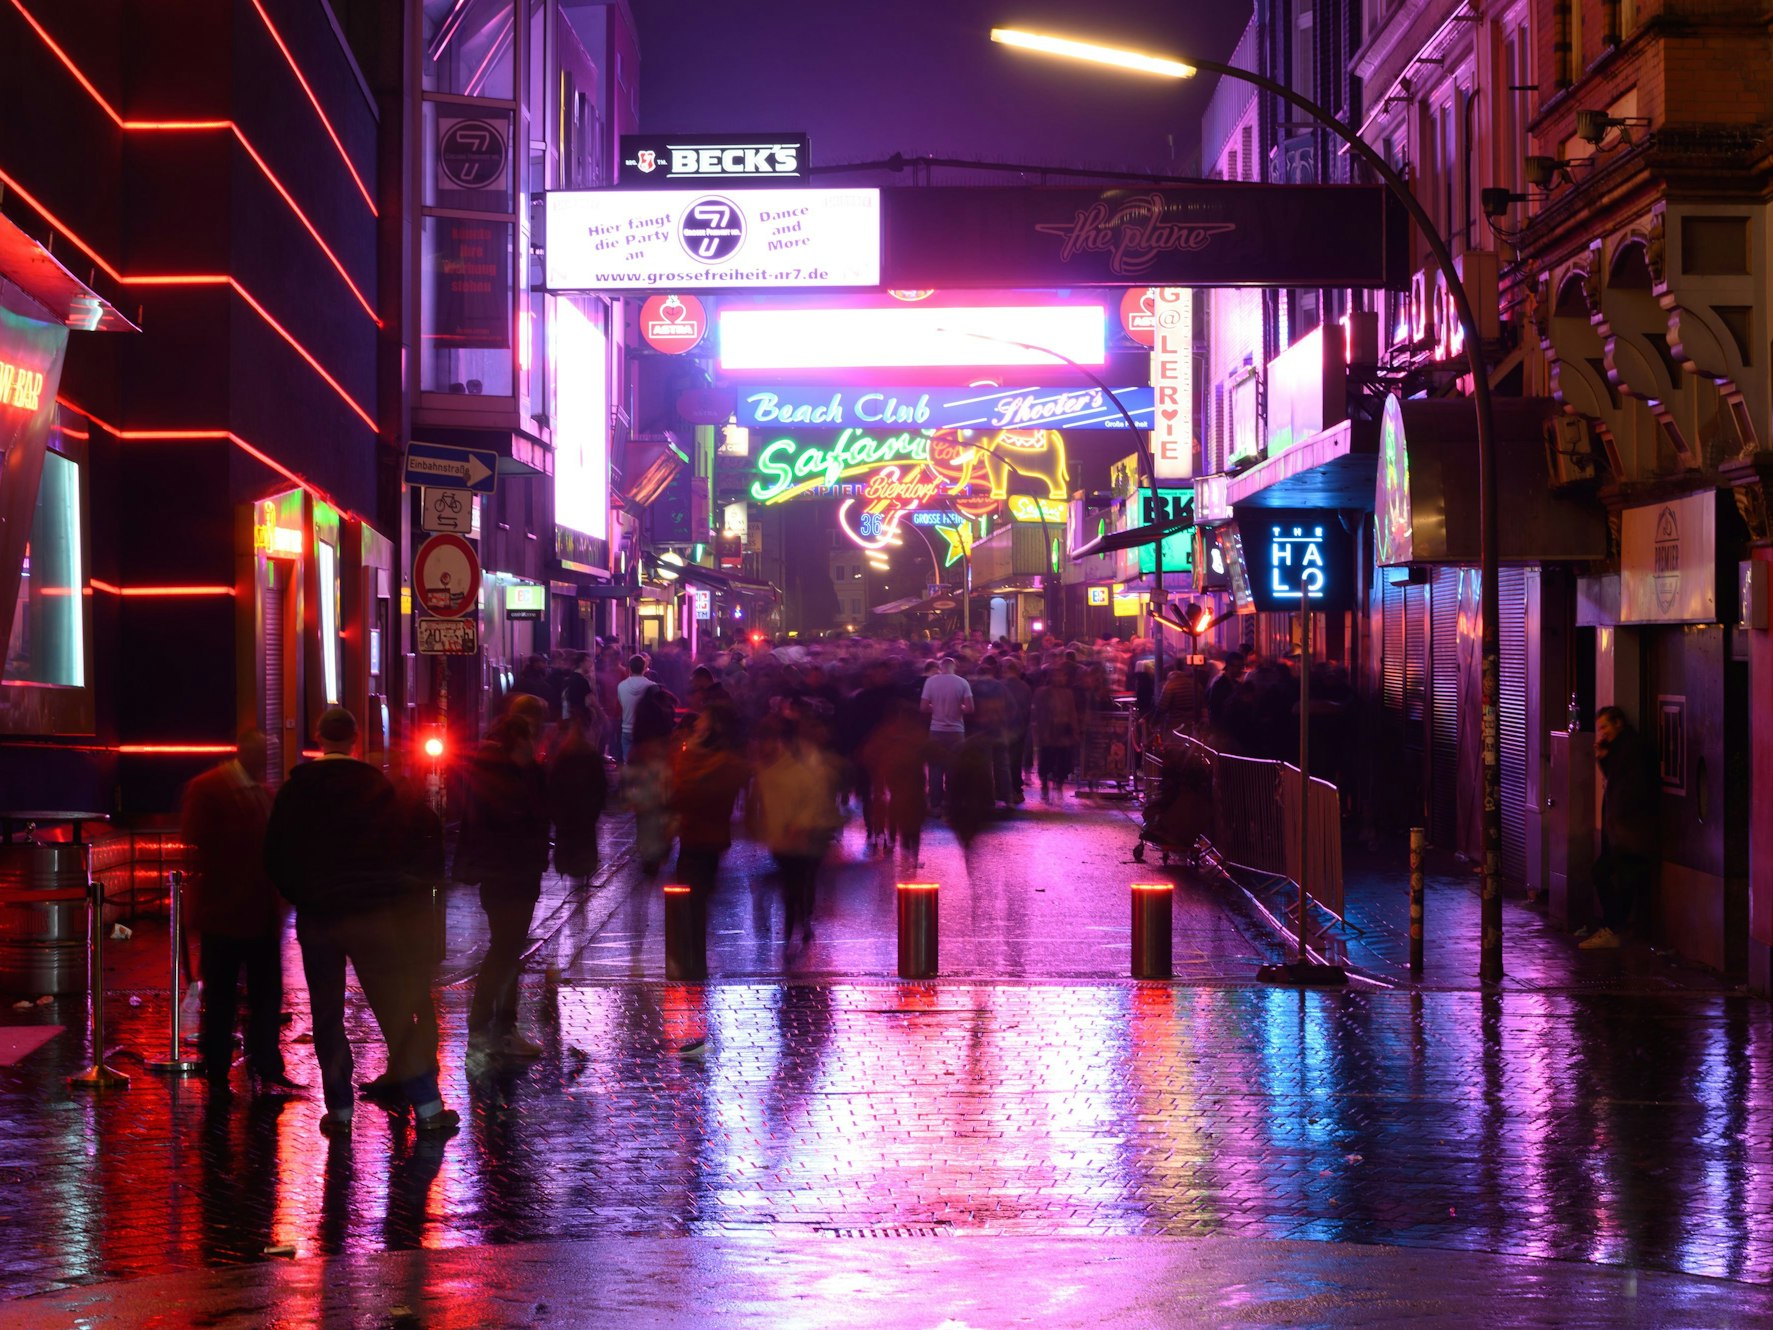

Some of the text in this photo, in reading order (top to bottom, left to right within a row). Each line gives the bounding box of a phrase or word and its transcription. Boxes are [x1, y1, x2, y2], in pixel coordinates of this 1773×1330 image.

[671, 145, 798, 173] BECK'S
[588, 213, 672, 237] Hier fängt
[760, 207, 809, 222] Dance
[772, 221, 802, 235] and
[1061, 194, 1208, 274] the plane
[595, 230, 669, 251] die Party
[768, 237, 811, 251] More
[625, 250, 644, 261] an
[653, 325, 693, 335] ASTRA
[746, 391, 930, 424] Beach Club
[991, 389, 1104, 427] Shooter's
[409, 458, 470, 474] Einbahnstraße
[751, 428, 936, 500] Safari
[865, 473, 938, 503] Bierdorf
[860, 513, 883, 536] 36
[913, 513, 941, 524] GROSSE
[1272, 527, 1323, 537] THE
[1655, 544, 1679, 572] PREMIER
